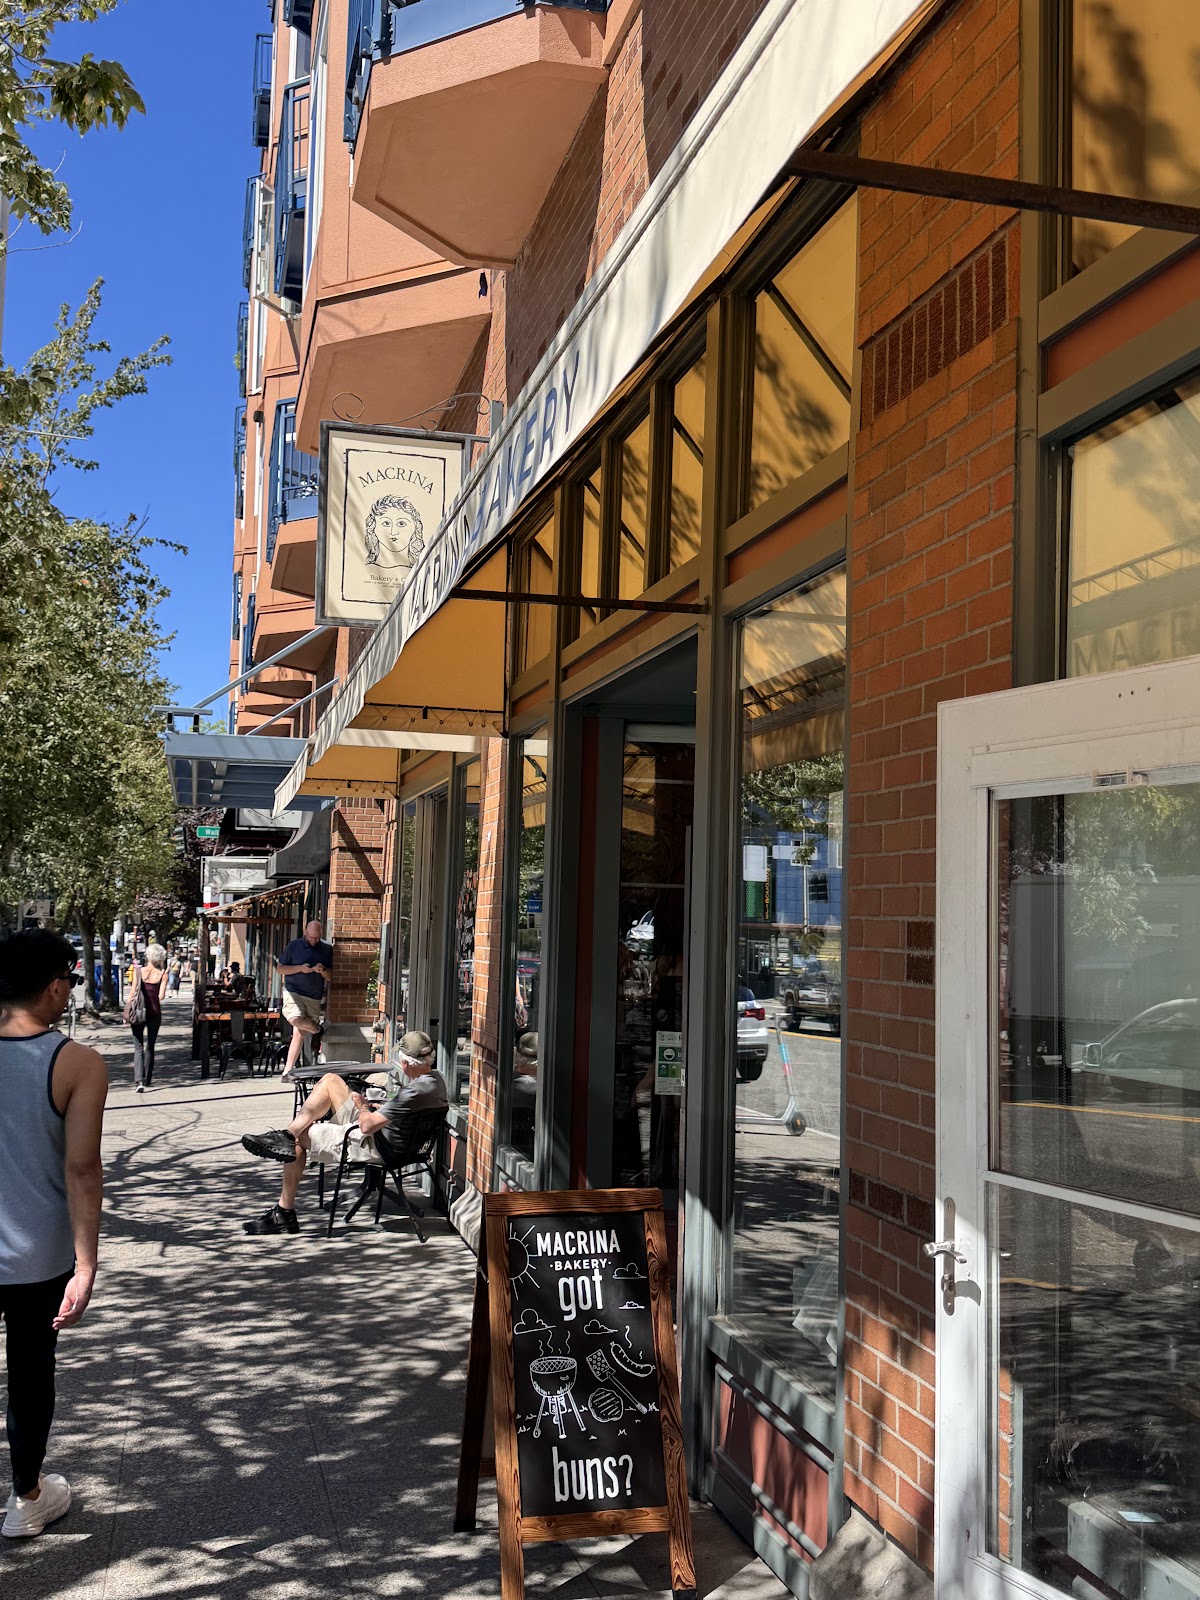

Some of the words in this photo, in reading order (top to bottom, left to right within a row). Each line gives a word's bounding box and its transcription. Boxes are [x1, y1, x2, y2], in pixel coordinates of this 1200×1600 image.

[471, 351, 580, 543] BAKERY
[358, 467, 434, 495] MACRINA
[370, 574, 393, 583] Bakery
[536, 1229, 620, 1257] MACRINA
[558, 1269, 603, 1321] got
[552, 1446, 634, 1502] buns?
